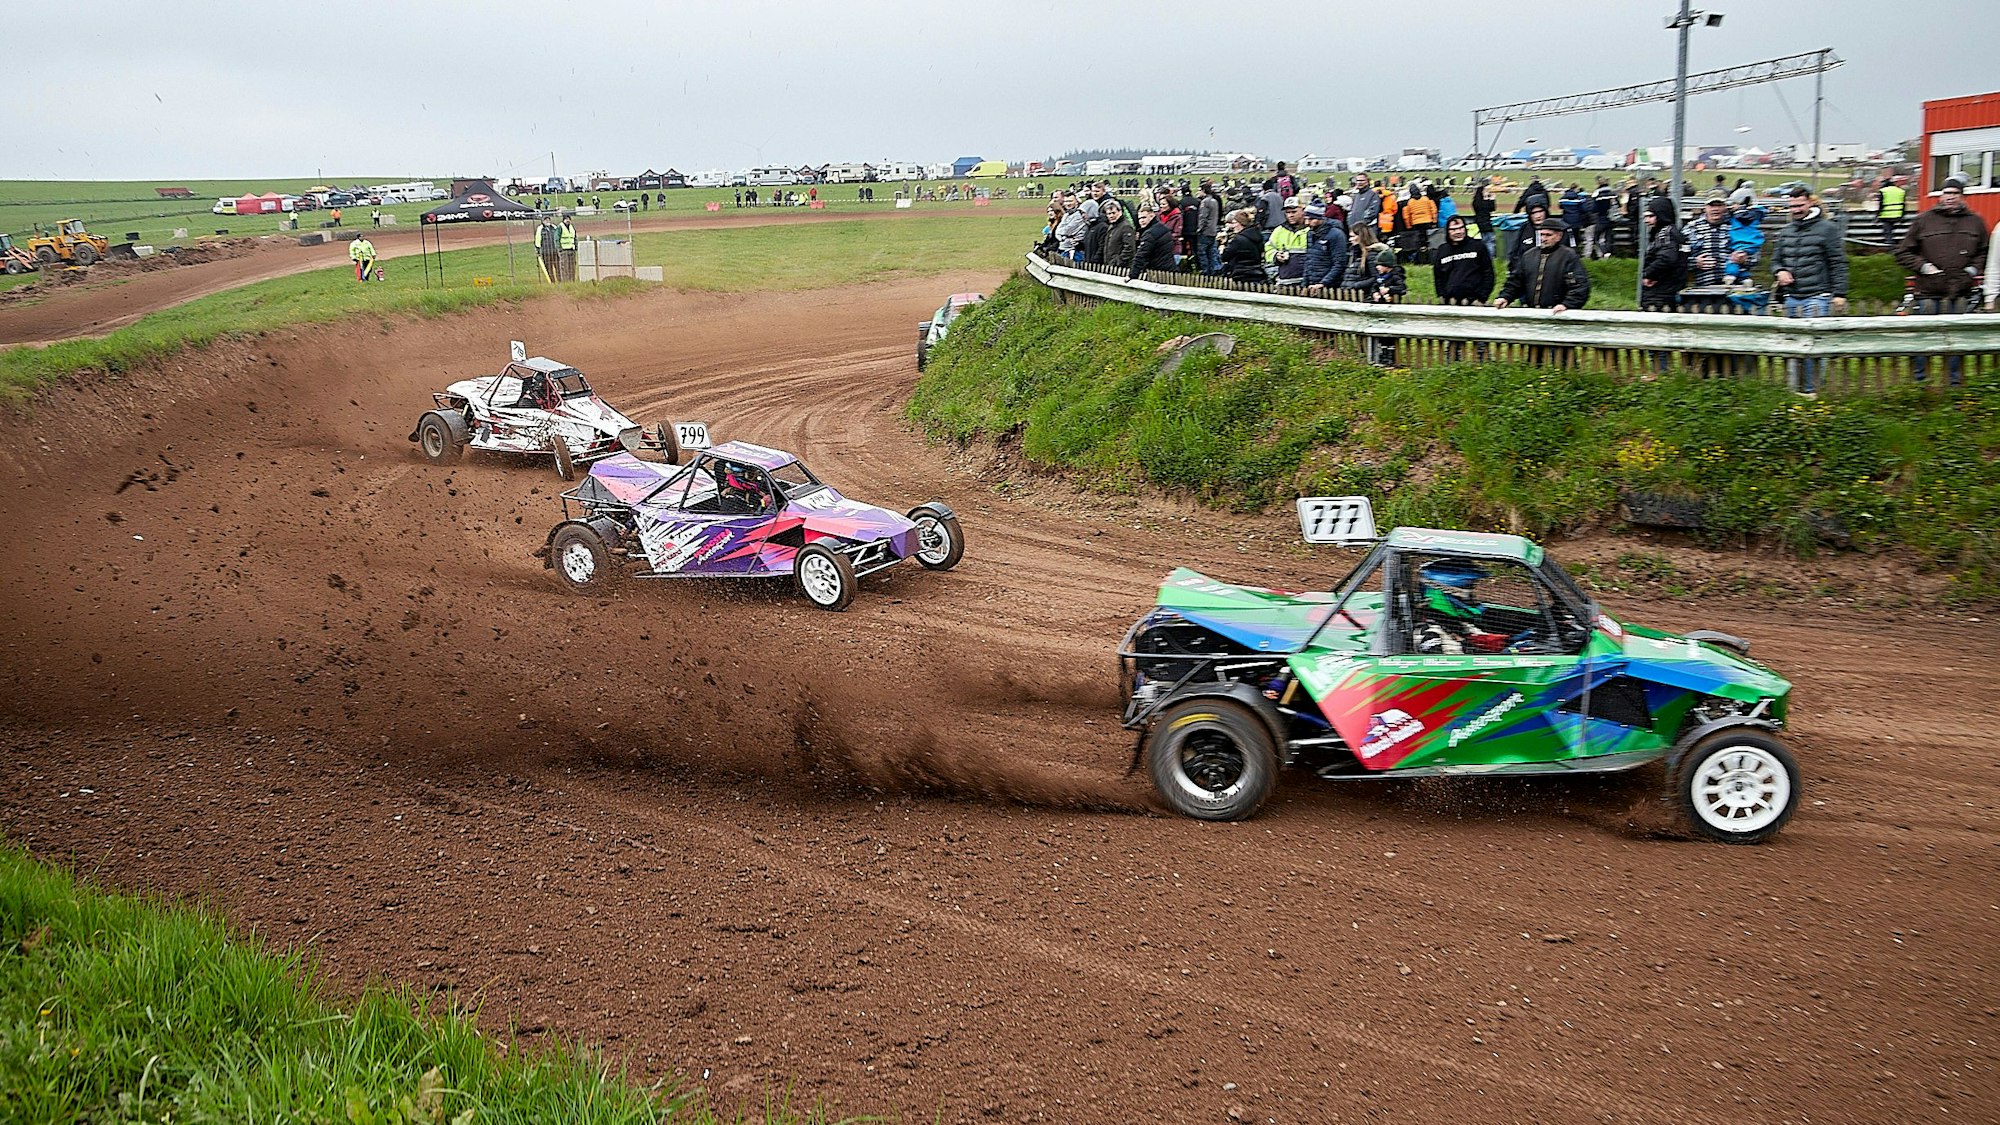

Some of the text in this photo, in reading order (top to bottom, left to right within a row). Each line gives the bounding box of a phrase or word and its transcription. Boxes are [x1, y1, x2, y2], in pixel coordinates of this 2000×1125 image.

[437, 212, 470, 221] 24MX
[493, 210, 526, 218] 24MX
[680, 426, 705, 445] 799
[1311, 504, 1359, 534] 777
